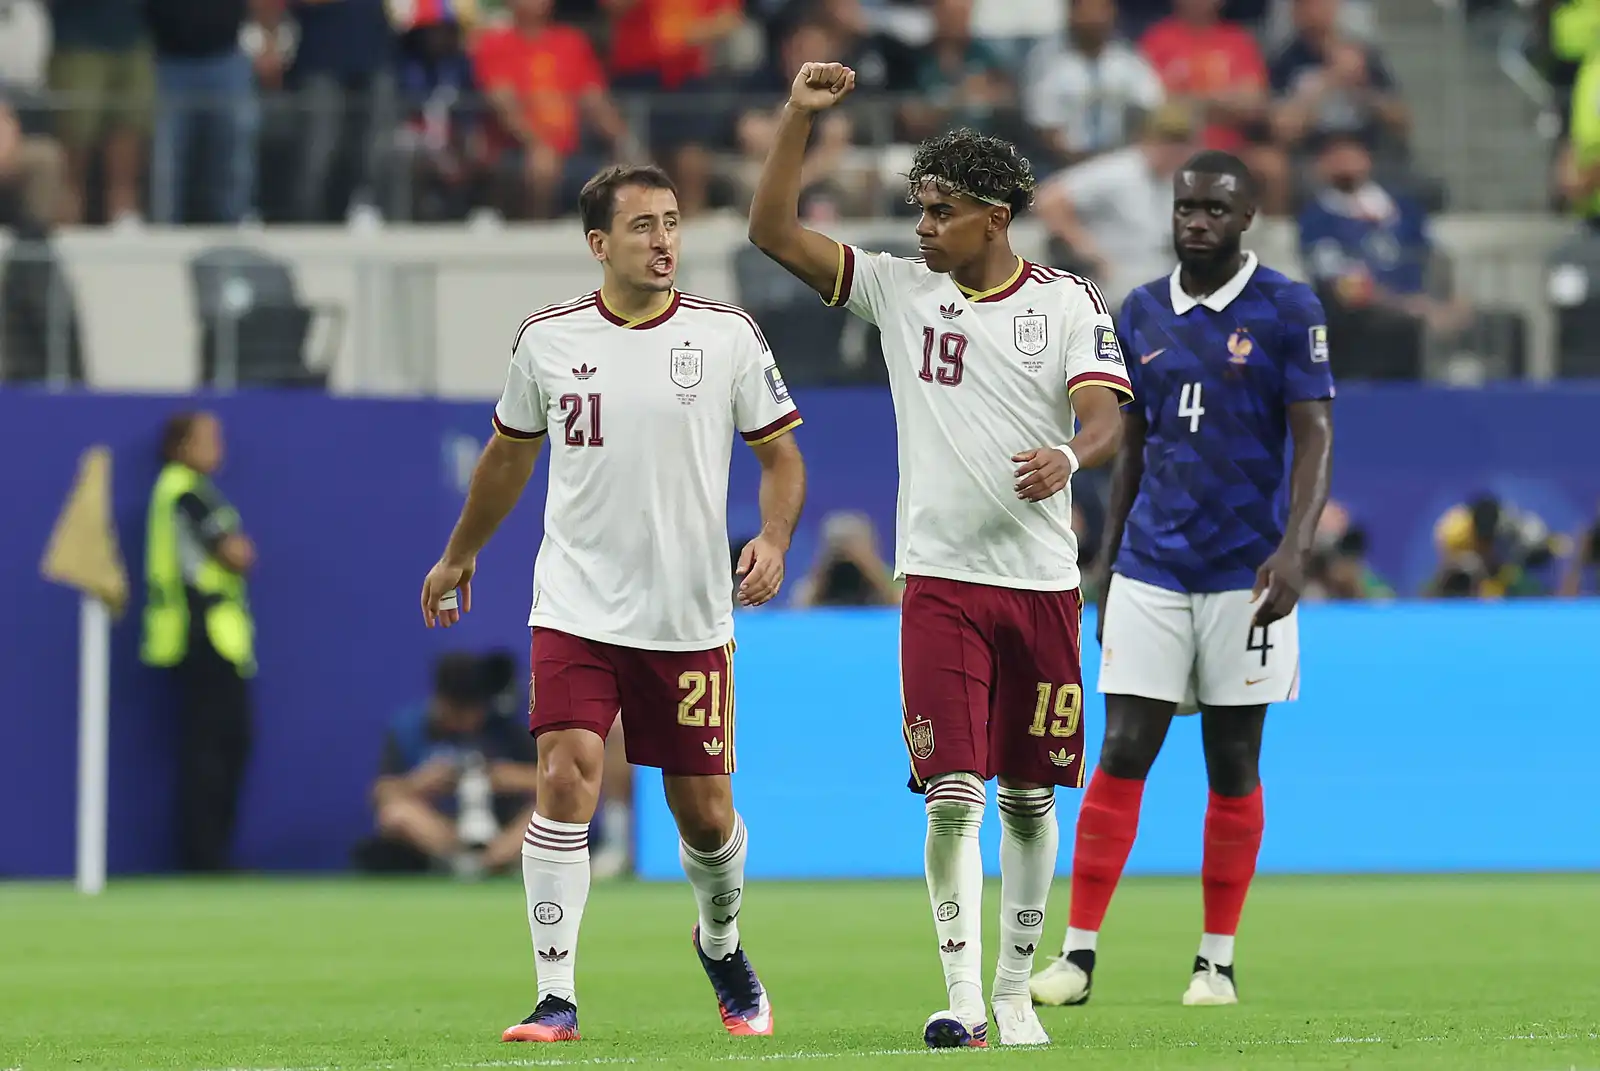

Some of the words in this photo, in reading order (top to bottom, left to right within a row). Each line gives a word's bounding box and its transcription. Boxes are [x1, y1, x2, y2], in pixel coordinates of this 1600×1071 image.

[918, 325, 969, 388] 19
[559, 392, 605, 447] 21
[1177, 381, 1206, 433] 4
[1246, 624, 1274, 668] 4
[677, 671, 721, 727] 21
[1028, 682, 1082, 738] 19
